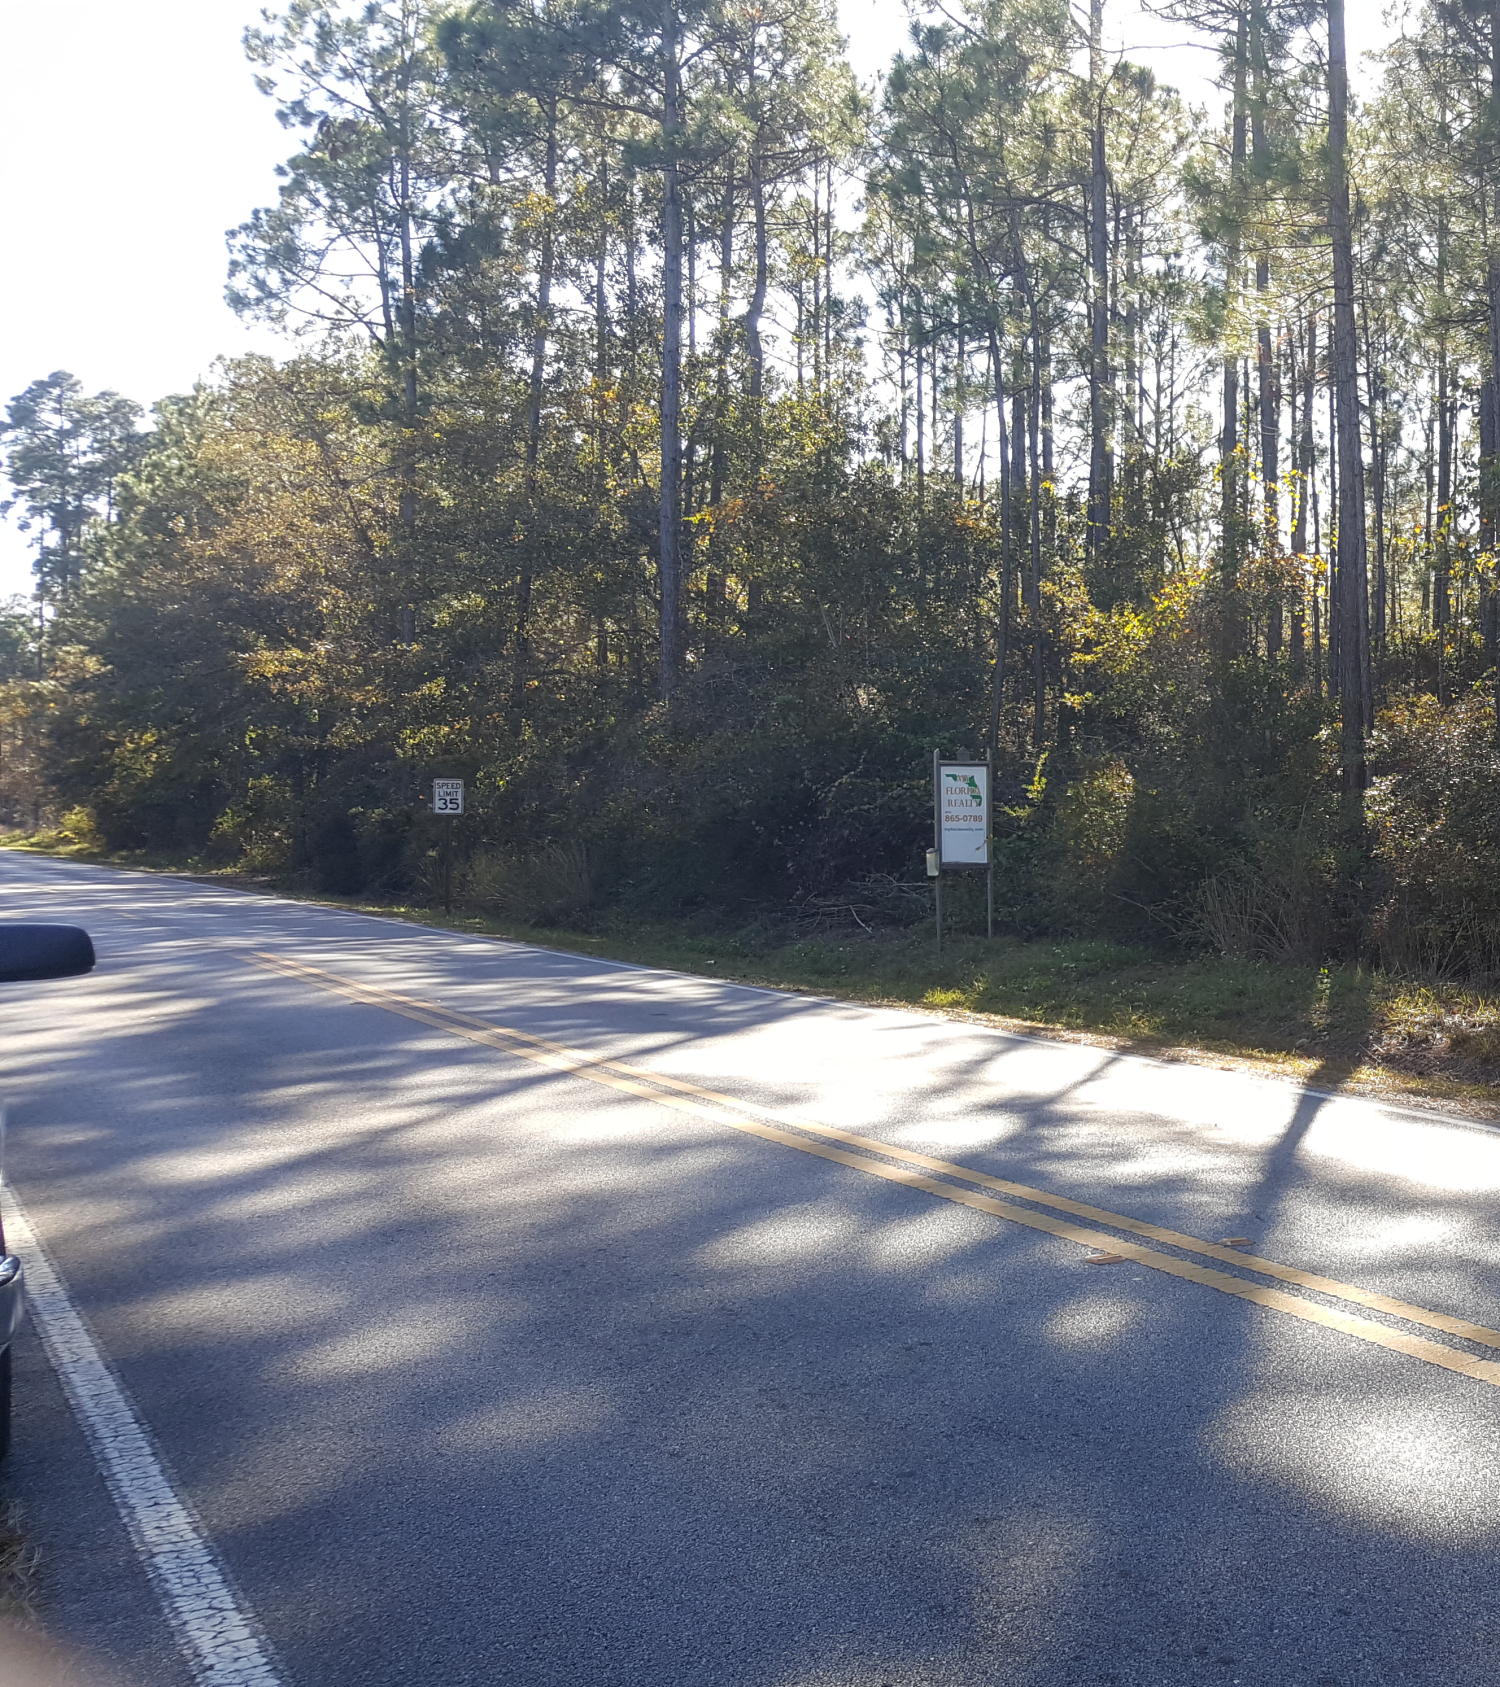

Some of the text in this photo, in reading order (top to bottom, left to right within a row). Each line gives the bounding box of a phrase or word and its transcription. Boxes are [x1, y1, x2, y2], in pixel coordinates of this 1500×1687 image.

[946, 786, 981, 795] FLORIDA
[438, 798, 460, 811] 35
[948, 799, 982, 808] REALTY
[944, 814, 983, 822] 865-0789
